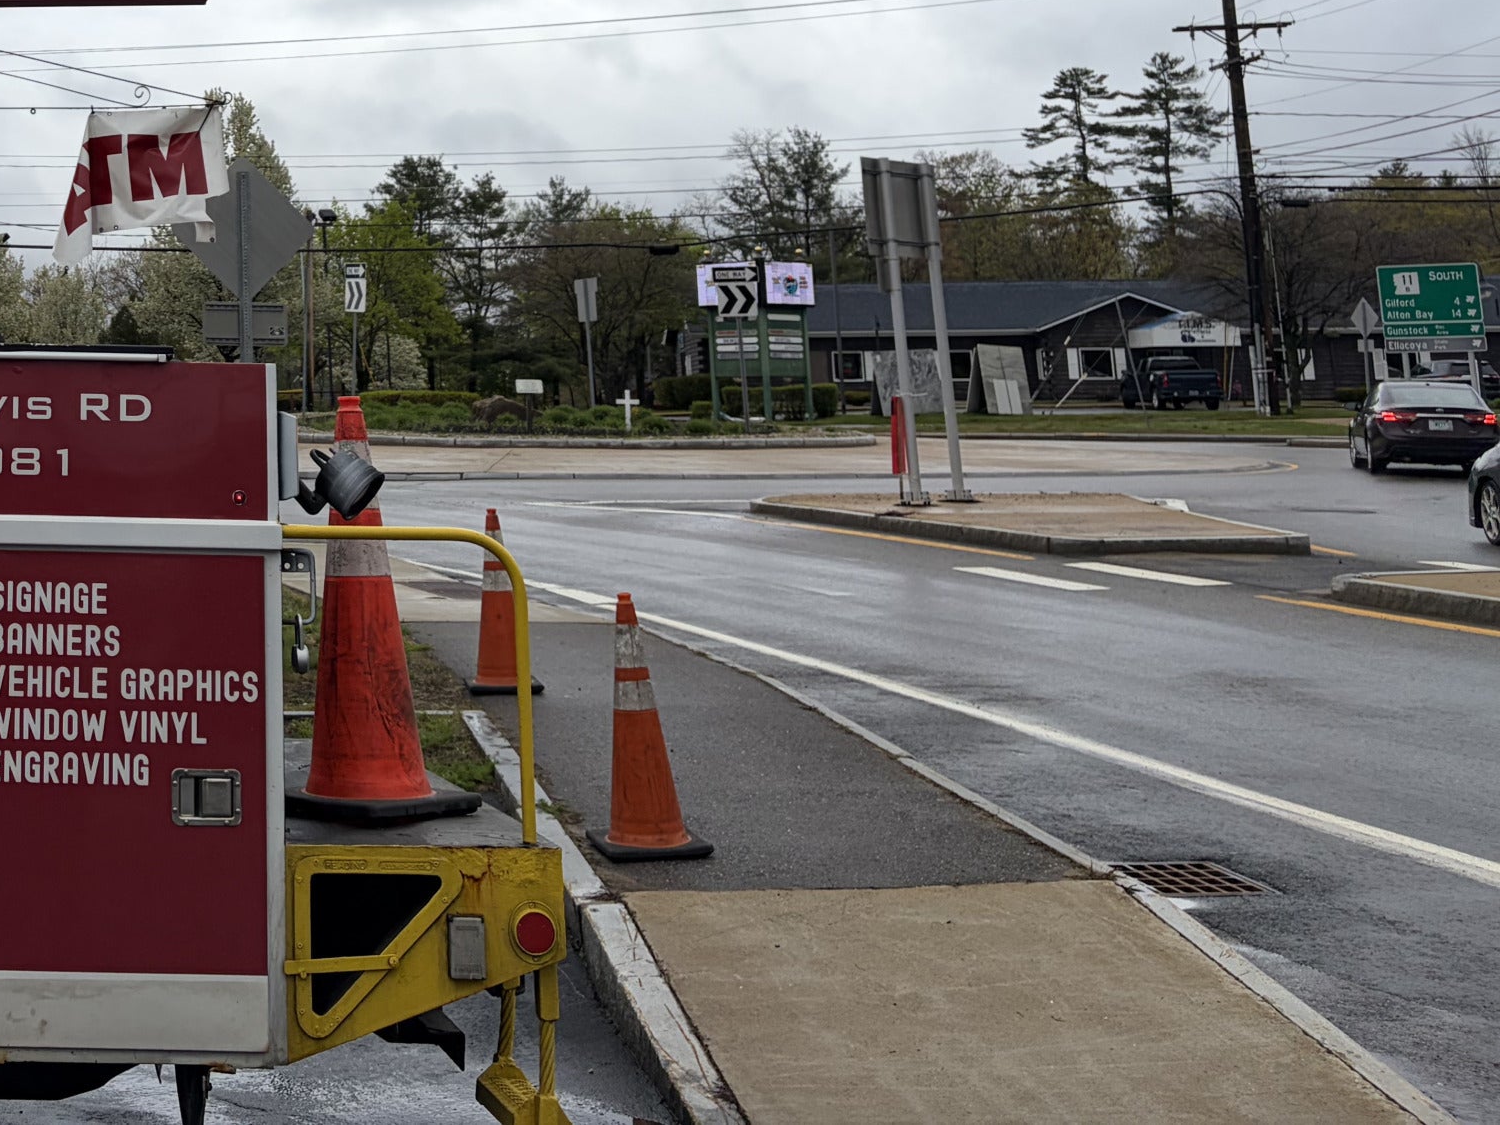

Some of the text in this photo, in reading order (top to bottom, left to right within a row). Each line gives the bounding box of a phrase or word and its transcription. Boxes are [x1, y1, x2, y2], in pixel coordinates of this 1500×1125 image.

[63, 130, 209, 237] ATM
[1402, 270, 1464, 286] 11 SOUTH
[1385, 296, 1461, 308] Gilford 4
[1386, 308, 1462, 322] Alton Bay 14
[1386, 326, 1429, 336] Gunstock
[1388, 340, 1428, 350] Ellacoya
[79, 393, 153, 422] RD
[120, 668, 259, 703] GRAPHICS
[119, 710, 208, 745] VINYL
